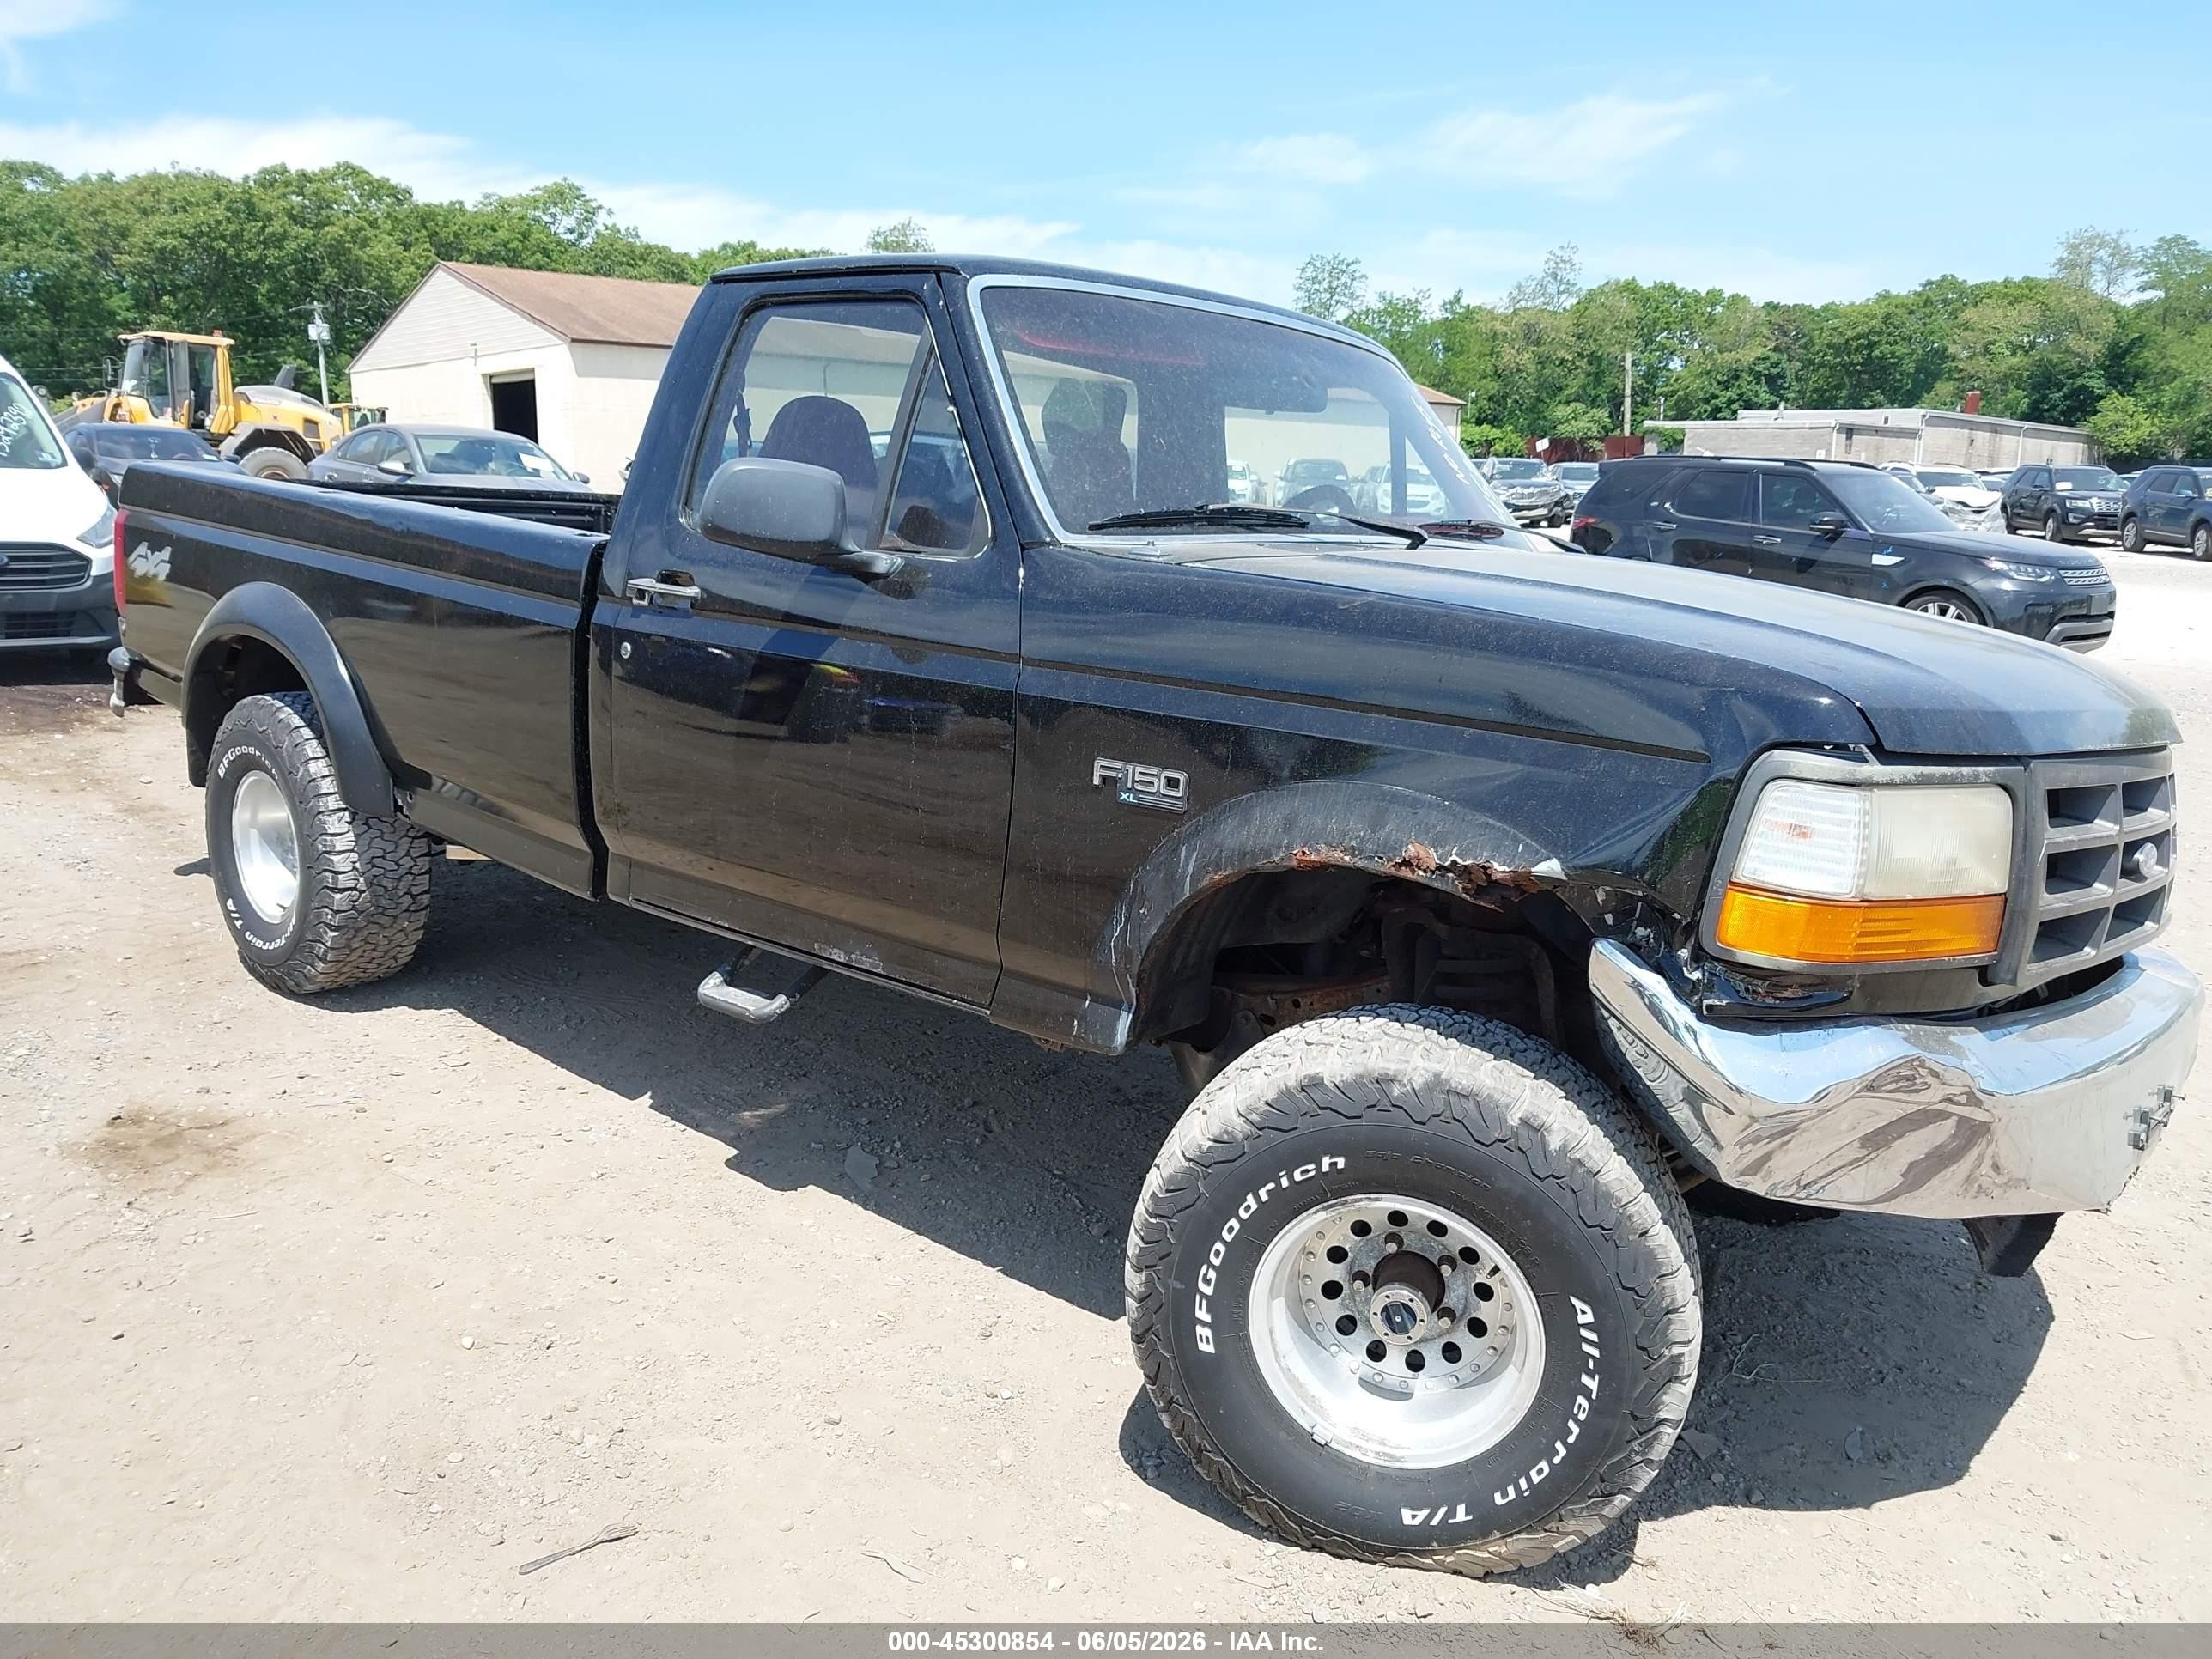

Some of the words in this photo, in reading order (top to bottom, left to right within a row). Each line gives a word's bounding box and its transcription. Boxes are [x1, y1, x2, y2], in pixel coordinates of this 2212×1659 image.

[1119, 791, 1139, 803] XL
[226, 897, 244, 929] T/A
[1194, 1155, 1346, 1354] BFGoodrich
[1493, 1295, 1601, 1505] All-Terrain
[1401, 1504, 1474, 1526] T/A
